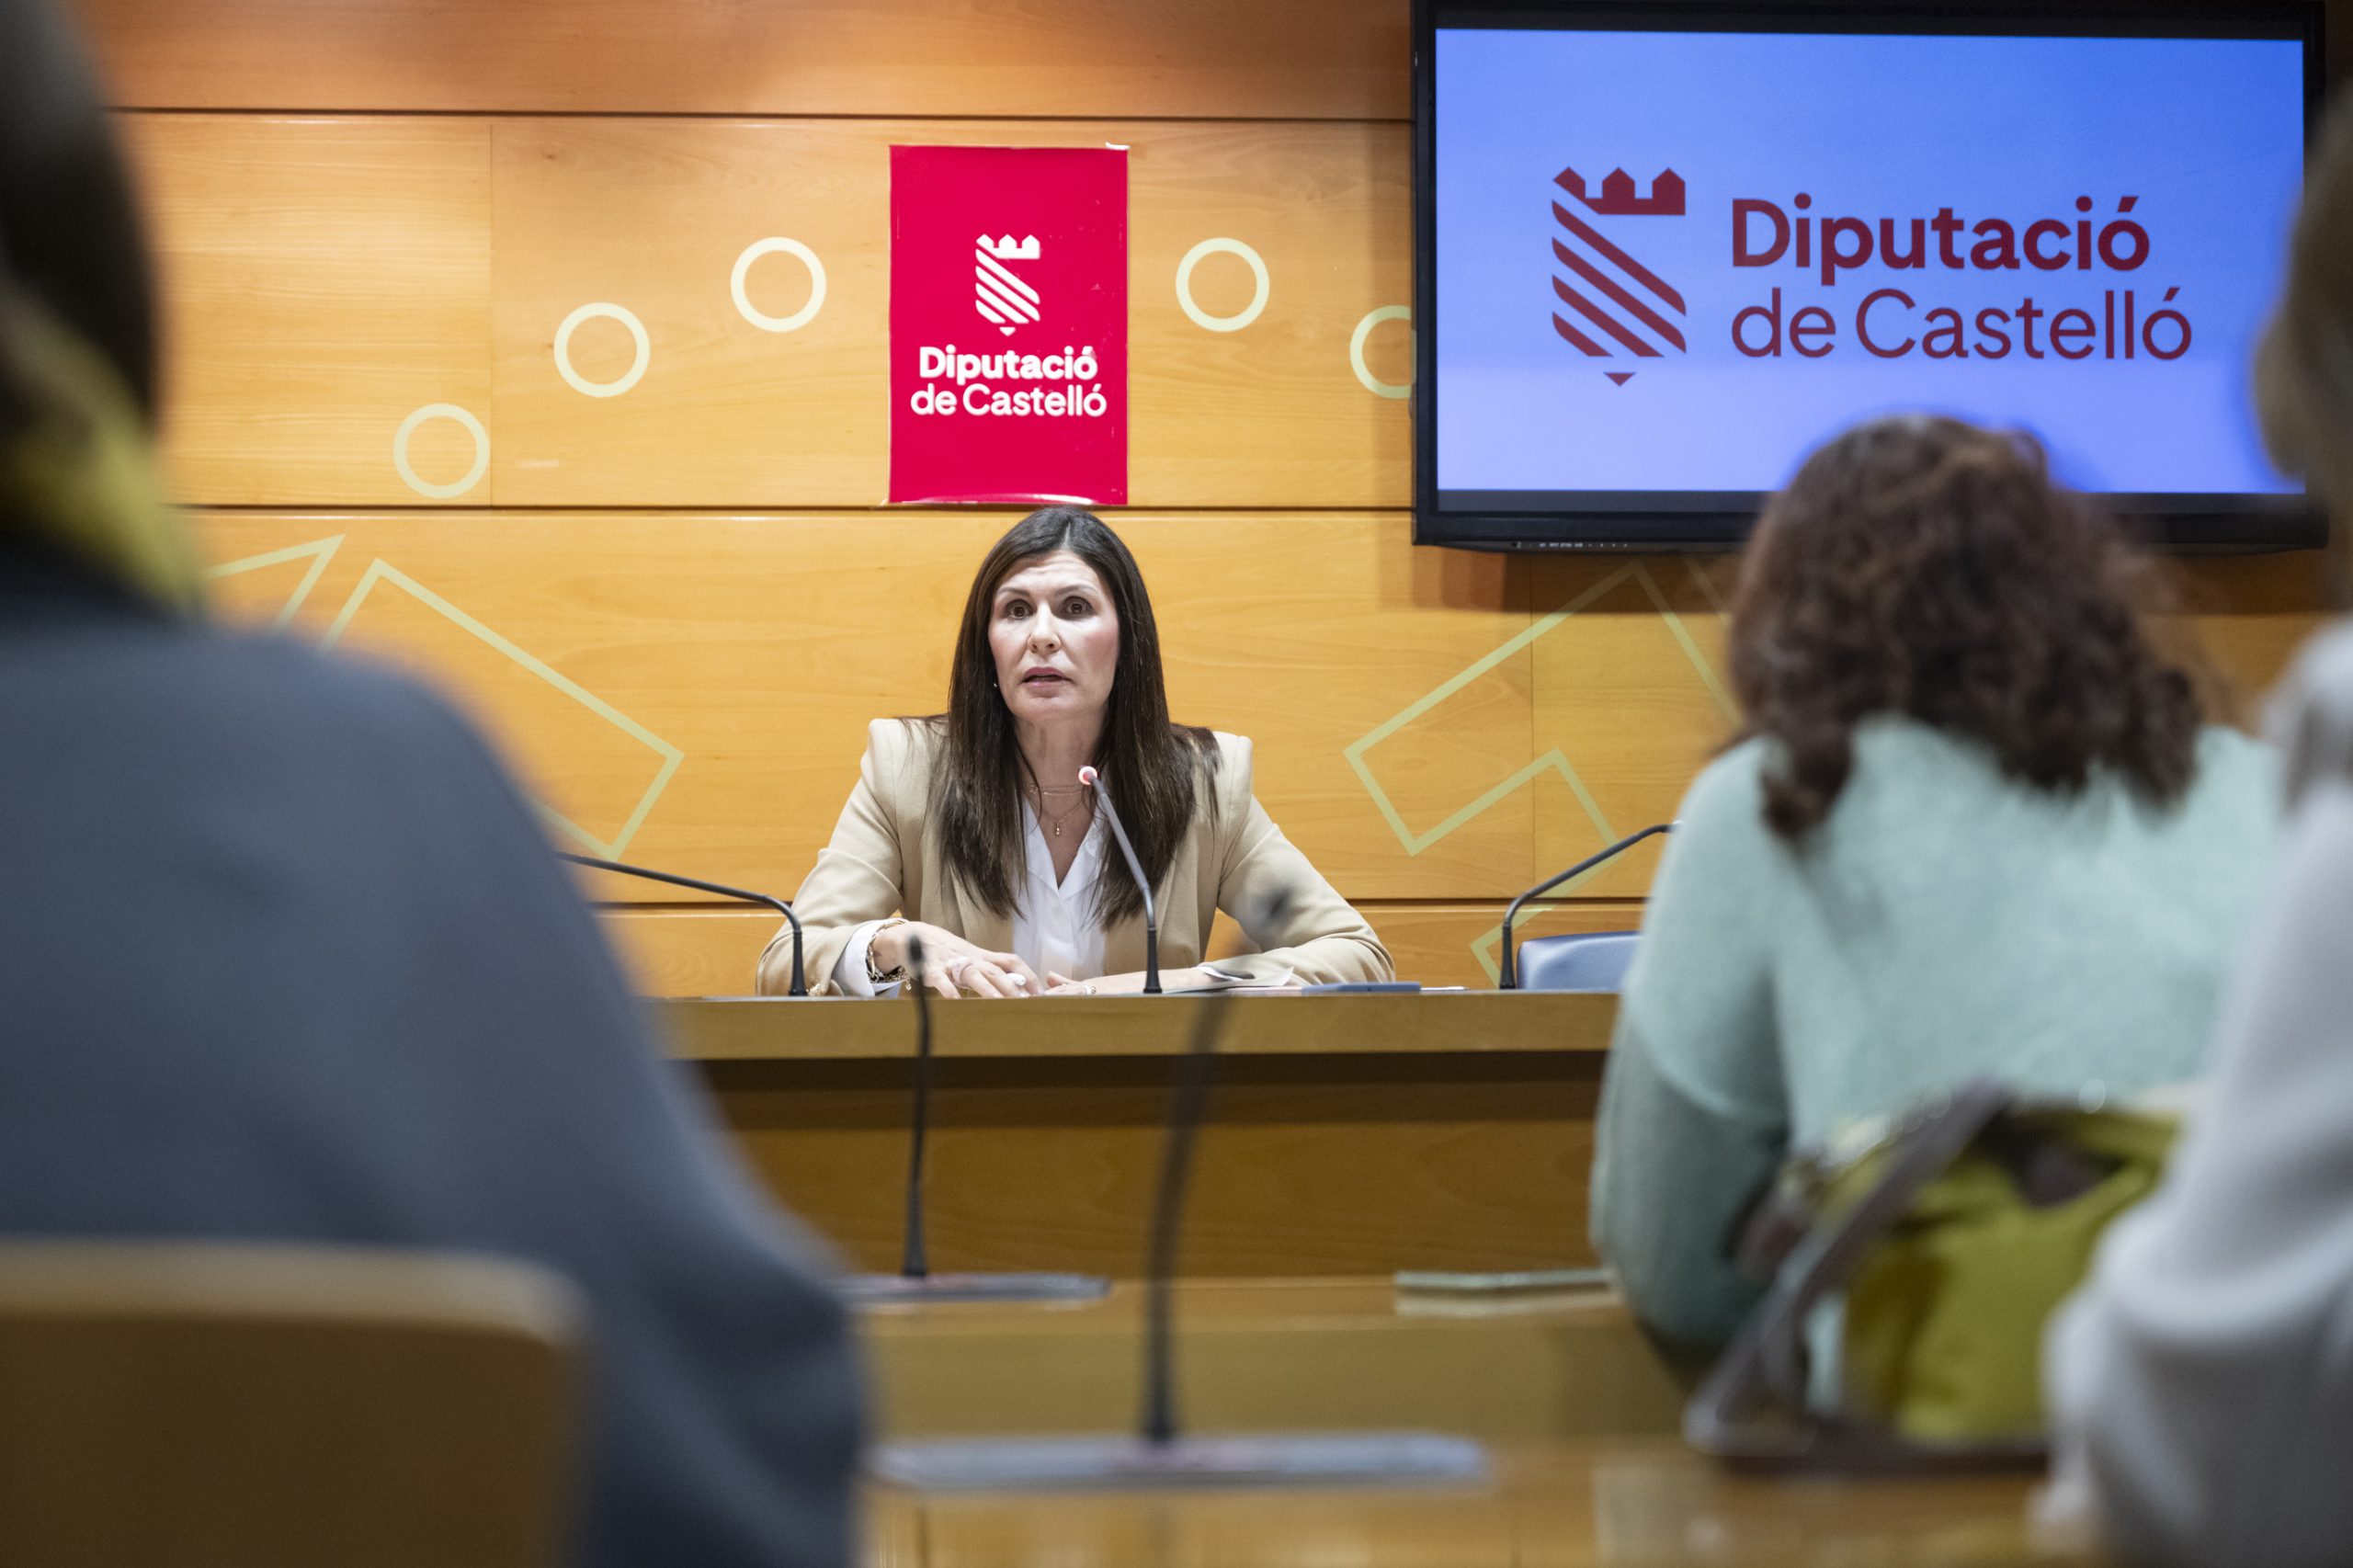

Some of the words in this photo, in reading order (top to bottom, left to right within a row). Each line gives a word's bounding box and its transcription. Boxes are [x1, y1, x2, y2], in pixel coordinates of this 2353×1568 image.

[1732, 192, 2151, 286] Diputació
[1732, 287, 1836, 358] de
[1856, 287, 2192, 360] Castelló
[918, 344, 1098, 386] Diputació
[910, 382, 957, 416] de
[962, 382, 1108, 417] Castelló
